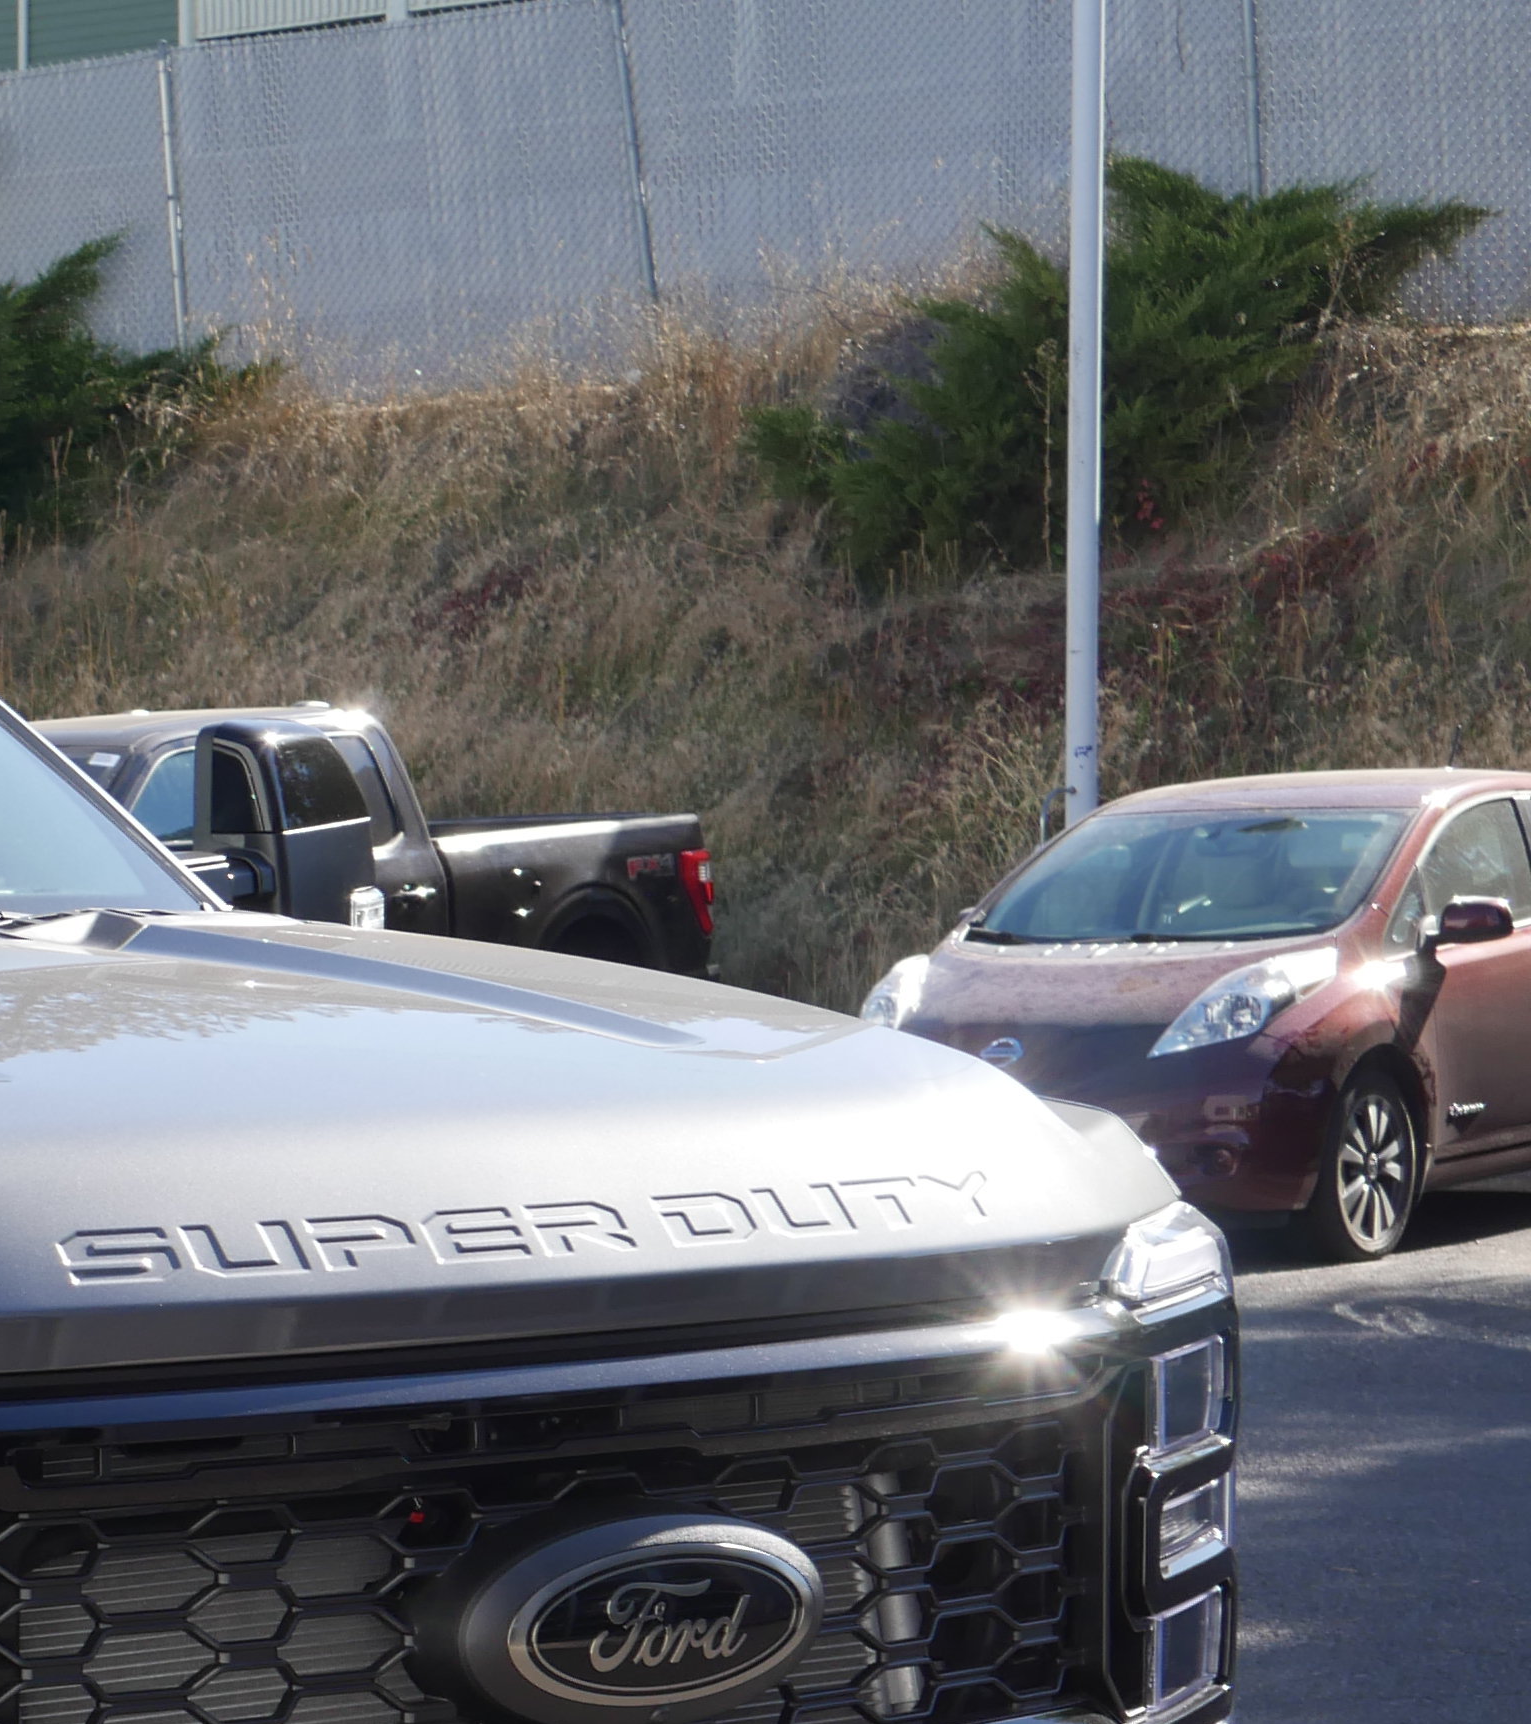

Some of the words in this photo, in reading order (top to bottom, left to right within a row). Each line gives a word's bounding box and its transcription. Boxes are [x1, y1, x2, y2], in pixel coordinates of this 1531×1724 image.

[55, 1200, 637, 1288] SUPER
[649, 1170, 988, 1250] DUTY
[590, 1578, 751, 1672] Ford
